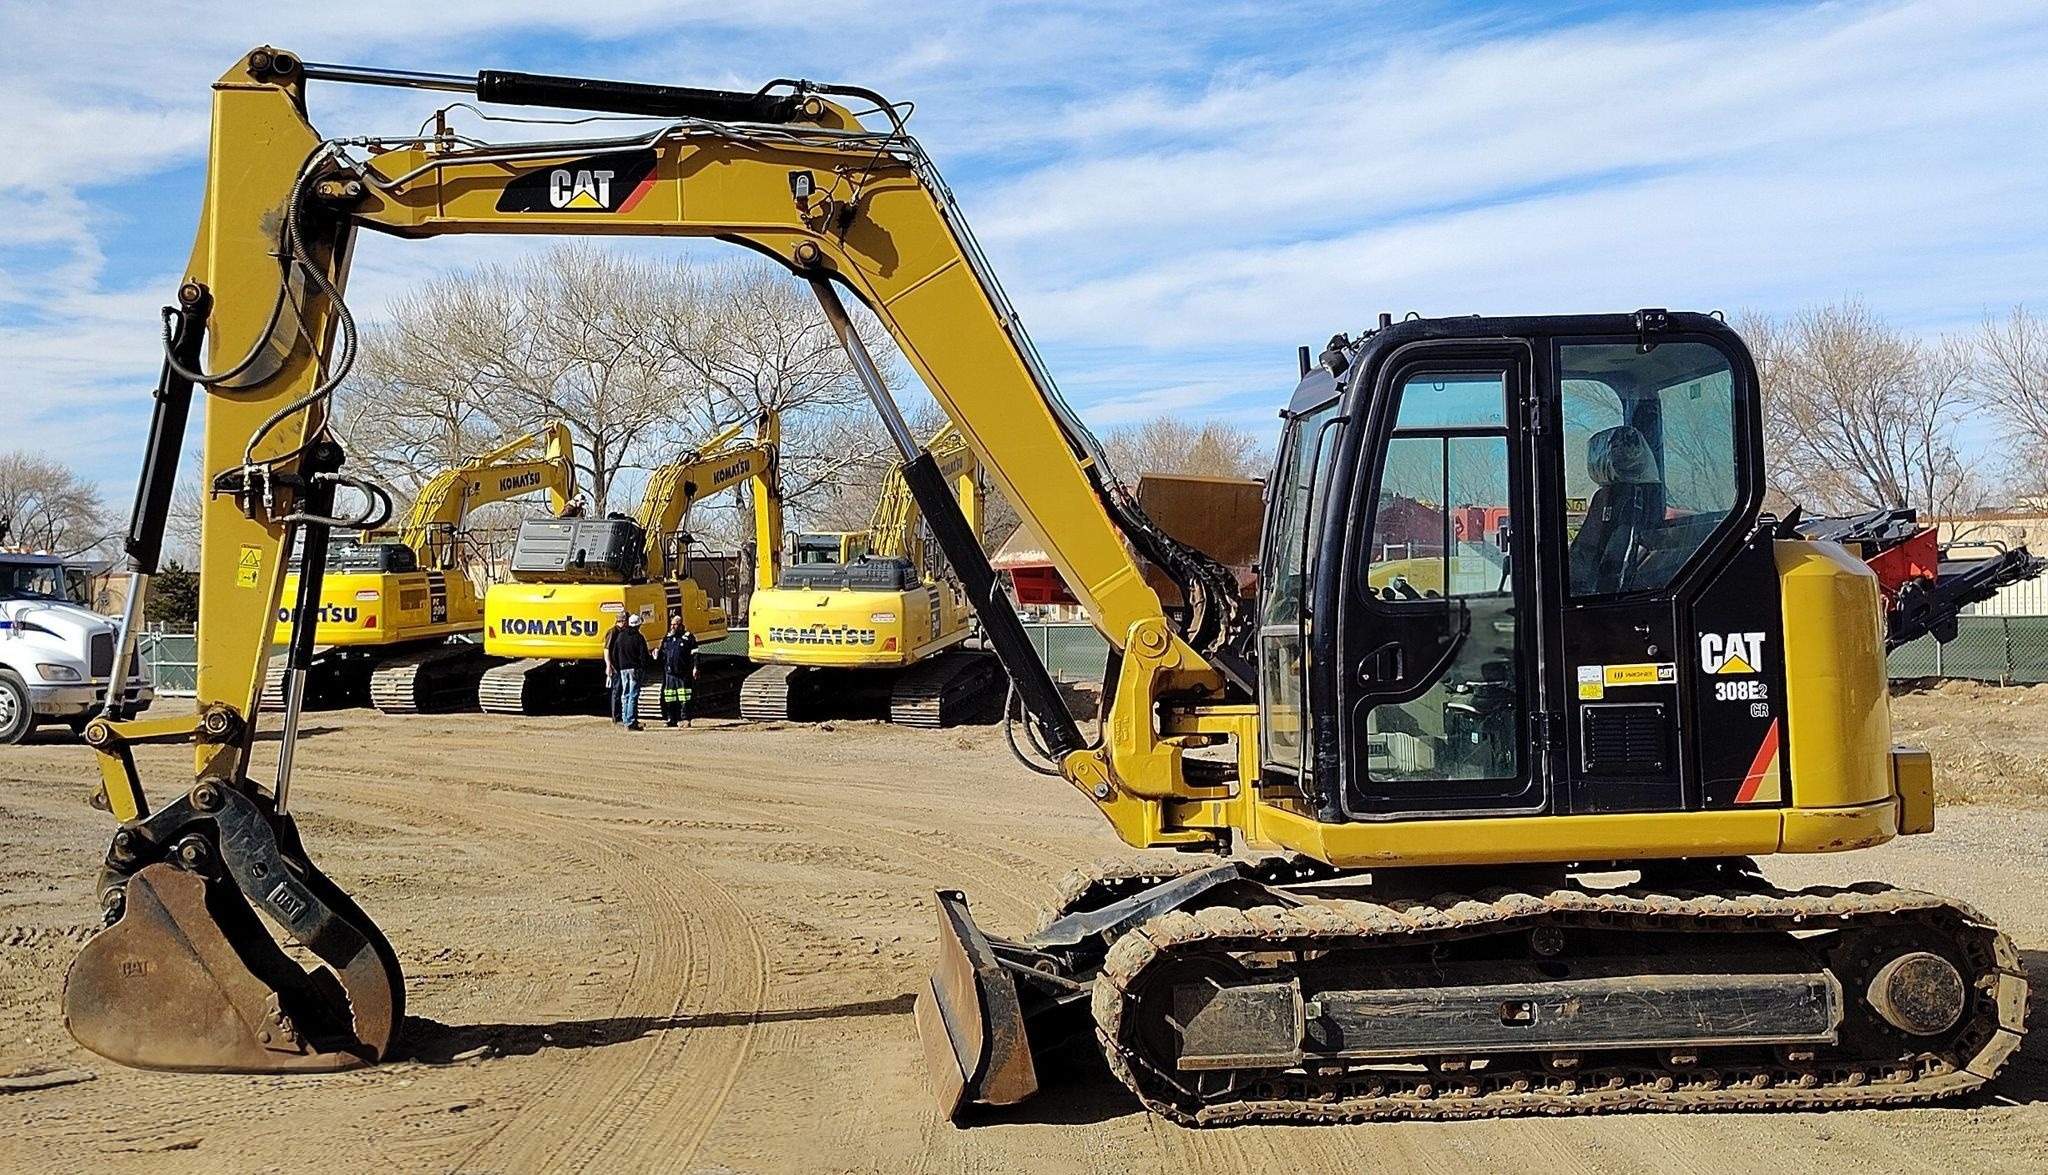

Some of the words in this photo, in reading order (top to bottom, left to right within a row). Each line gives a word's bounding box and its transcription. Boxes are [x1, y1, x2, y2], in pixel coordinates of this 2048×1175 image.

[550, 169, 615, 209] CAT
[499, 470, 541, 492] KOMATSU
[713, 458, 750, 485] KOMATSU
[501, 615, 599, 637] KOMATSU
[769, 624, 876, 646] KOMATSU
[1700, 632, 1766, 674] CAT
[1750, 702, 1769, 718] CR
